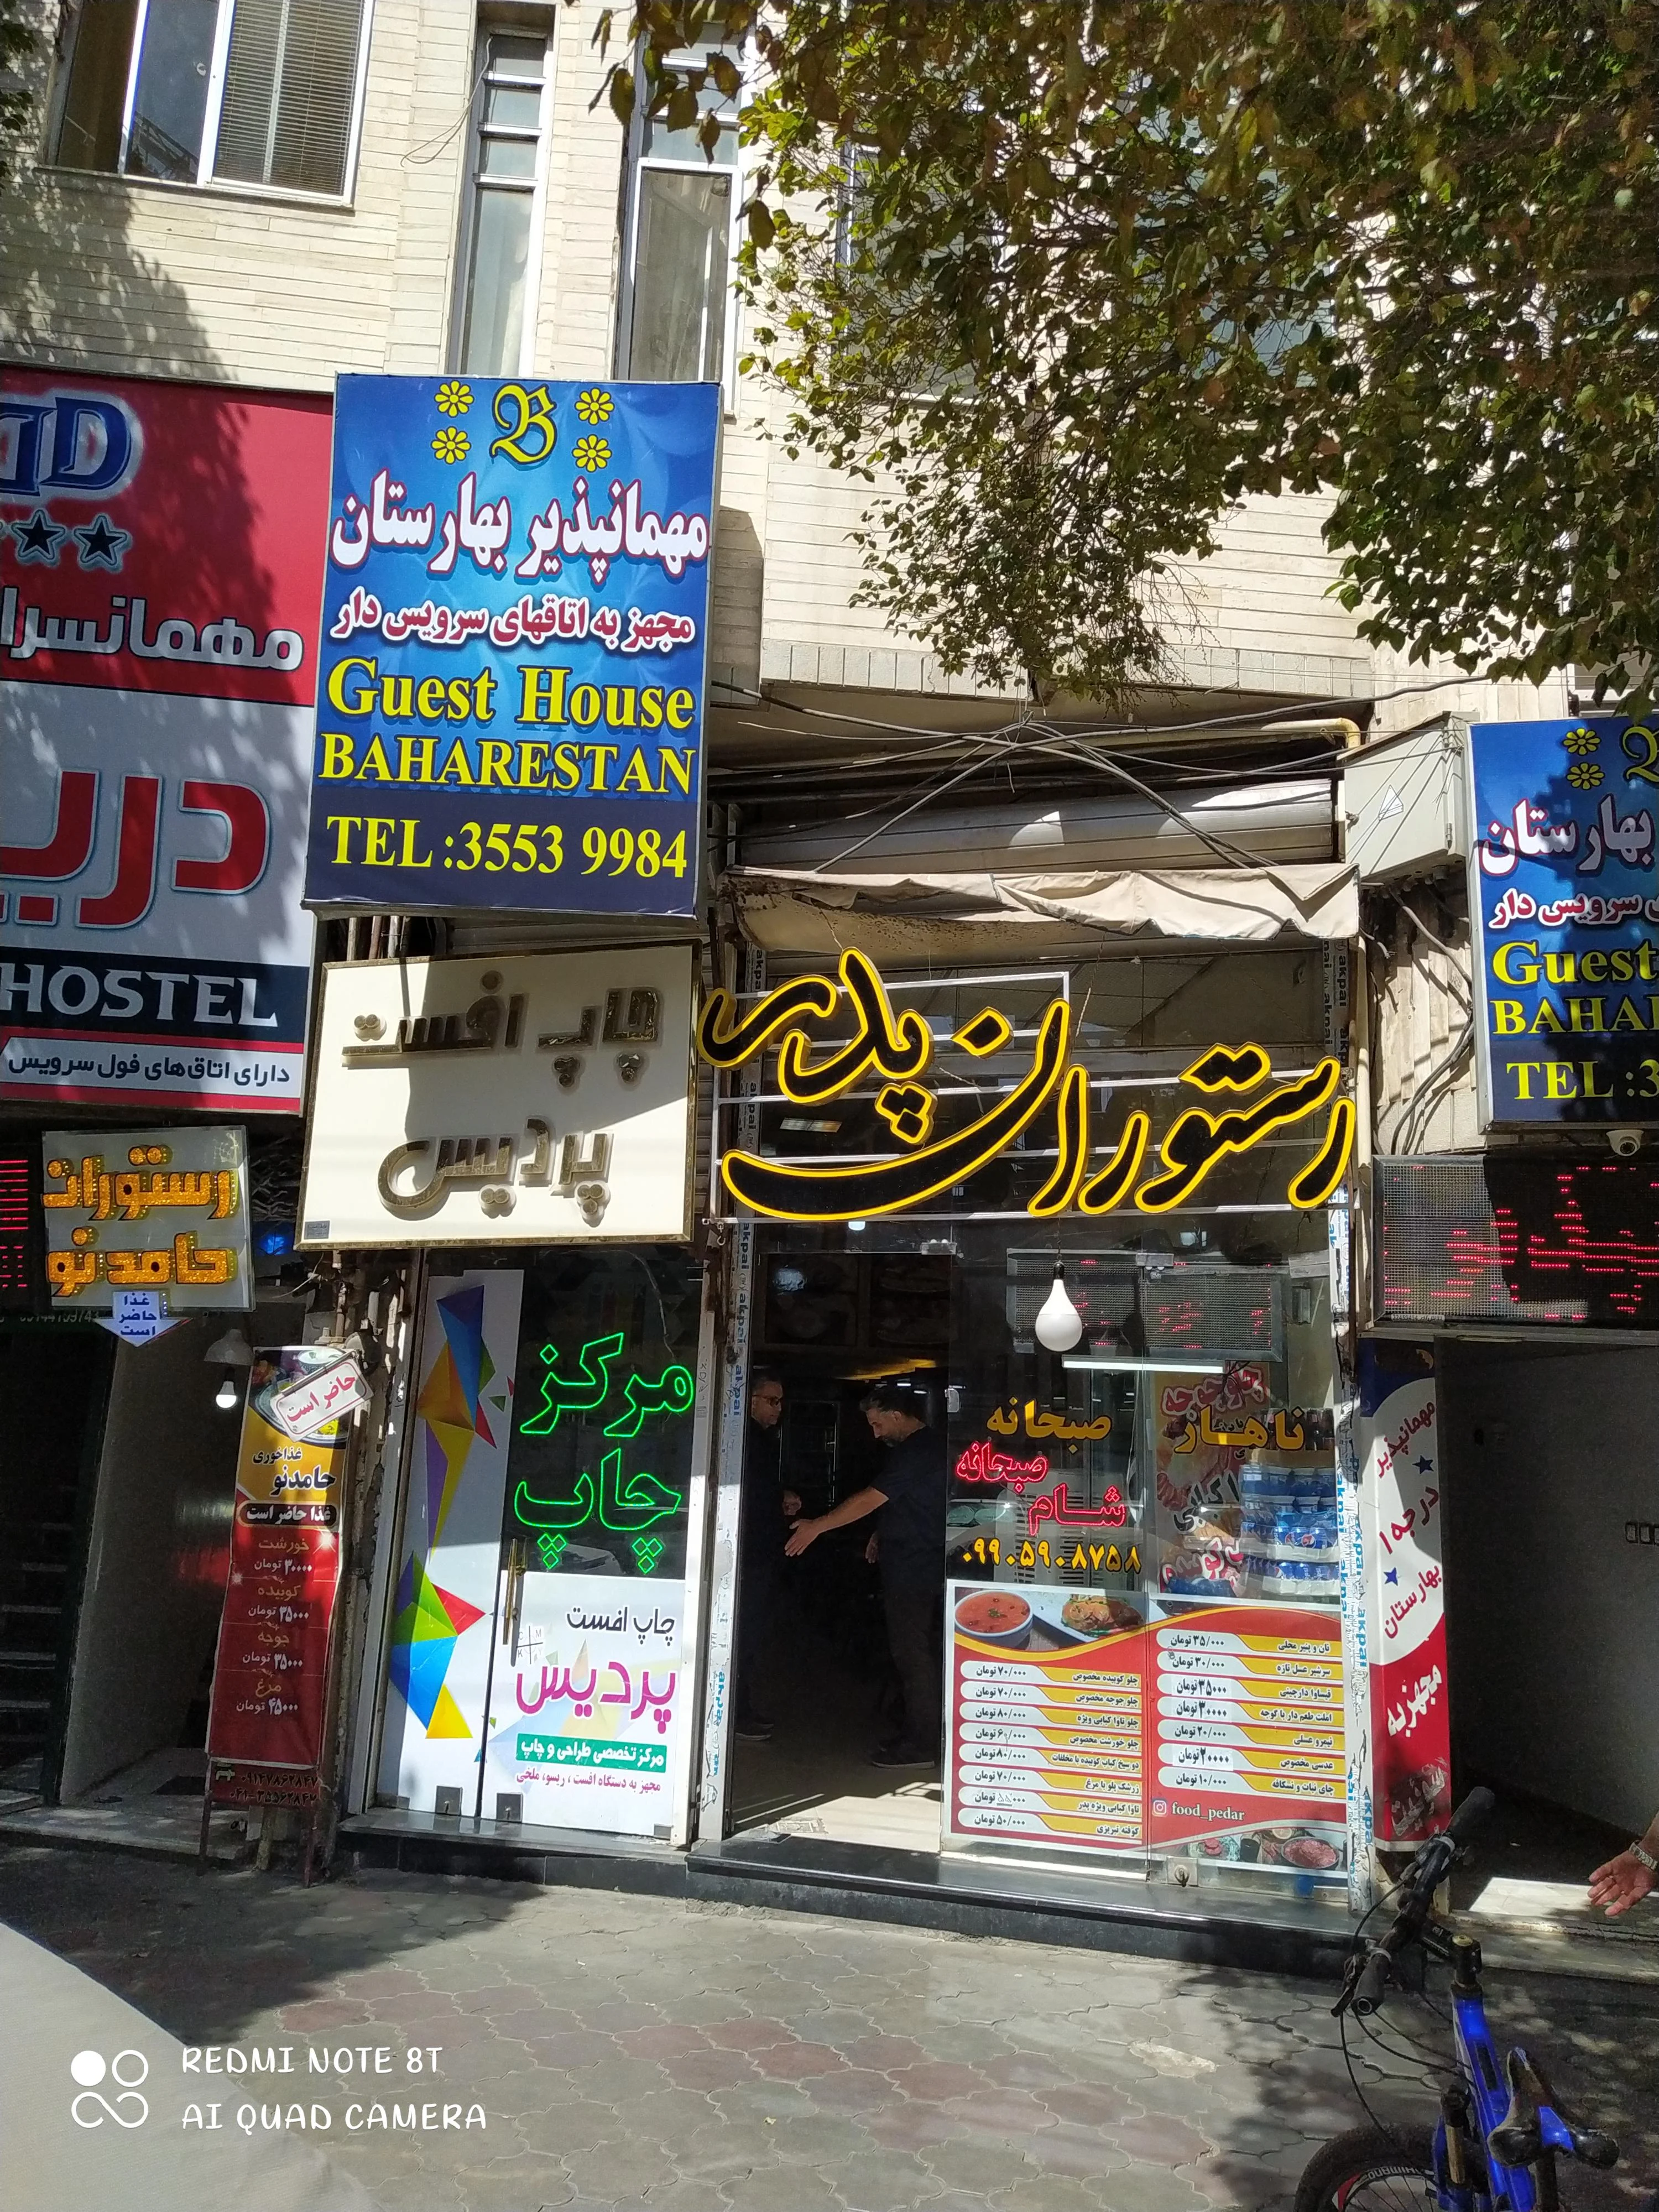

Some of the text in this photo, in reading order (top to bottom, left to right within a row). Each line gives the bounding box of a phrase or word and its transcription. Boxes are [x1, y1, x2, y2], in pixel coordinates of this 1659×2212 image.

[331, 468, 709, 583] مهمانپذیر بهارستان
[330, 586, 696, 651] مجهز به اتاقهای سرویس دار
[327, 656, 695, 729] Guest House
[319, 732, 697, 795] BAHARESTAN
[1479, 794, 1653, 877] بهارستان
[326, 815, 434, 868] TEL
[581, 827, 687, 878] 9984
[1489, 888, 1535, 928] دار
[1539, 893, 1641, 927] سرویس
[1493, 940, 1658, 985] Guest
[0, 962, 278, 1027] HOSTEL
[342, 971, 528, 1057] افست
[8, 1055, 95, 1076] سرویس
[97, 1053, 140, 1079] فول
[233, 1063, 290, 1087] دارای
[698, 947, 1356, 1219] رستوران پدر
[1506, 1060, 1614, 1099] TEL
[378, 1118, 611, 1221] پردیس
[41, 1146, 237, 1220] رستوران
[46, 1227, 235, 1298] حامدنو
[123, 1292, 150, 1307] غذا
[118, 1310, 157, 1324] حاضر
[120, 1325, 156, 1335] است
[520, 1332, 694, 1437] مرکز
[286, 1375, 355, 1422] حاضر است
[986, 1396, 1112, 1454] صبحانه
[1175, 1405, 1305, 1453] ناهار
[1377, 1402, 1435, 1478] مهمانپذیر
[253, 1447, 302, 1464] غذاخوری
[956, 1441, 1048, 1492] صبحانه
[270, 1464, 336, 1497] حامدنو
[246, 1505, 331, 1525] غذا حاضر است
[514, 1447, 682, 1574] چاپ
[1029, 1484, 1126, 1538] شام
[1391, 1486, 1439, 1541] درجه
[258, 1537, 310, 1554] خورشت
[254, 1558, 312, 1575] ۳۰۰۰۰ تومان
[258, 1585, 301, 1601] کوبیده
[1384, 1564, 1442, 1639] بهارستان
[248, 1605, 309, 1623] ۳۵۰۰۰ تومان
[567, 1606, 675, 1646] چاپ افست
[258, 1634, 290, 1648] جوجه
[1170, 1635, 1224, 1647] ۳۵/۰۰۰ تومان
[1279, 1640, 1329, 1653] نان محلی
[242, 1651, 303, 1670] ۳۵۰۰۰ تومان
[1172, 1657, 1225, 1669] ۳۰/۰۰۰ تومان
[1292, 1665, 1307, 1674] عسل
[976, 1666, 1026, 1677] ۷۰/۰۰۰ تومان
[1073, 1673, 1138, 1684] چلو کوبیده مخصوص
[255, 1678, 282, 1698] مرغ
[975, 1687, 1026, 1698] ۷۰/۰۰۰ تومان
[1176, 1679, 1227, 1697] ۳۵۰۰۰ تومان
[1280, 1688, 1309, 1698] دارچینی
[236, 1698, 298, 1715] ۴۵۰۰۰ تومان
[516, 1661, 676, 1734] پردیس
[1076, 1694, 1138, 1705] چلو جوجه مخصوص
[975, 1708, 1026, 1719] ۸۰/۰۰۰ تومان
[1176, 1700, 1227, 1718] ۳۰۰۰۰ تومان
[1261, 1709, 1278, 1719] گوجه
[1126, 1718, 1139, 1727] چلو
[1175, 1725, 1226, 1738] ۲۰/۰۰۰ تومان
[975, 1729, 1026, 1740] ۶۰/۰۰۰ تومان
[1070, 1735, 1139, 1747] چلو خورشت مخصوص
[1293, 1735, 1313, 1745] عسلی
[521, 1739, 664, 1768] مرکز تخصصی طراحی چاپ
[975, 1749, 1026, 1760] ۸۰/۰۰۰ تومان
[1081, 1757, 1100, 1767] کوبیده
[1178, 1747, 1229, 1765] ۲۰۰۰۰ تومان
[1280, 1759, 1333, 1771] عدسی مخصوص
[516, 1767, 540, 1782] ملخی
[598, 1775, 627, 1788] دستگاه
[975, 1770, 1026, 1782] ۷۰/۰۰۰ تومان
[1176, 1773, 1227, 1786] ۱۰/۰۰۰ تومان
[629, 1779, 637, 1792] به
[639, 1778, 661, 1794] مجهز
[1086, 1780, 1099, 1790] مرغ
[1272, 1781, 1294, 1791] نسکافه
[975, 1792, 996, 1803] تومان
[974, 1814, 1025, 1825] ۵۰/۰۰۰ تومان
[1172, 1802, 1244, 1820] food_pedar
[1121, 1827, 1139, 1835] کوفته
